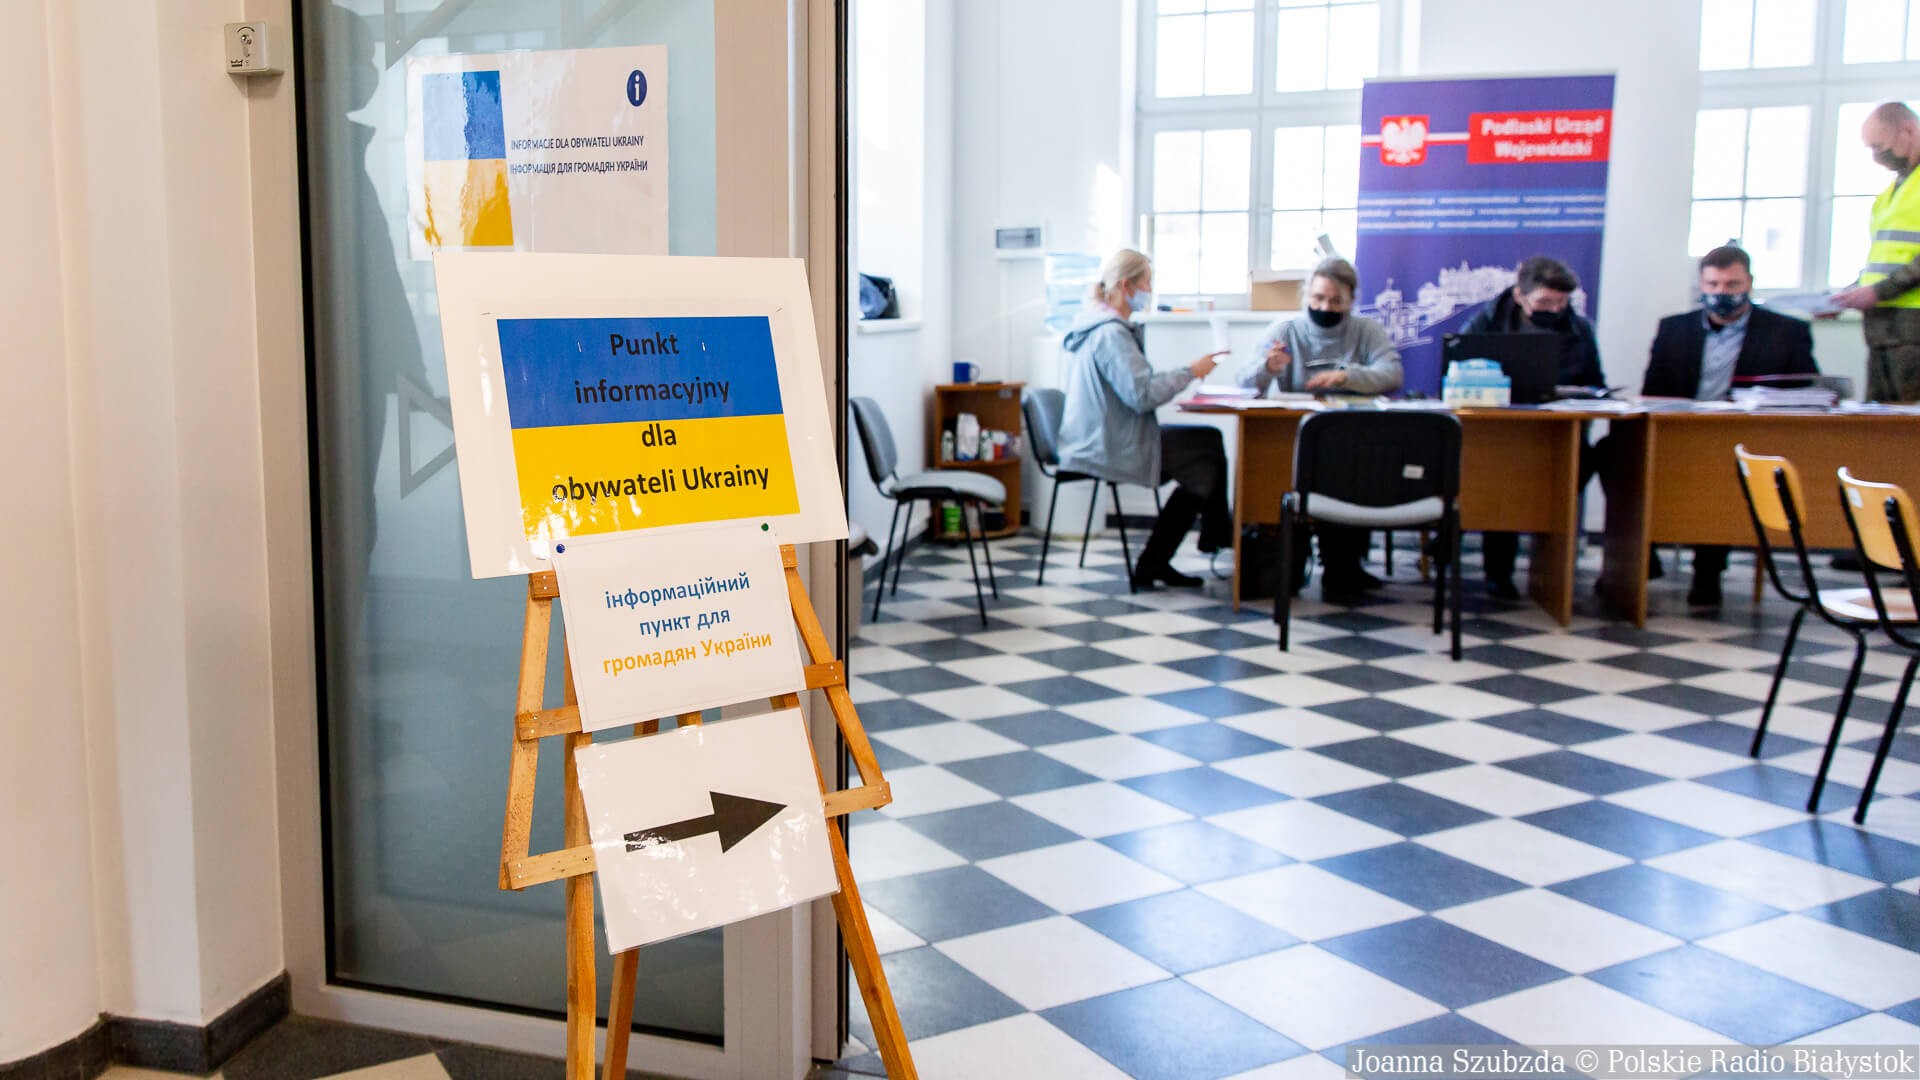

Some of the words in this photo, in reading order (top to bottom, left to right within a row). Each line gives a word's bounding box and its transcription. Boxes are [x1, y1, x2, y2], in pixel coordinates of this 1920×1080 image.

[1481, 117, 1552, 136] Podlaski
[1554, 115, 1605, 137] Urząd
[511, 137, 554, 150] INFORMACJE
[555, 137, 569, 149] DLA
[570, 136, 611, 149] OBYWATELI
[612, 135, 644, 147] UKRAINY
[1494, 139, 1592, 161] Wojewódzki
[510, 162, 556, 175] ІНФОРМАЦІЯ
[557, 162, 573, 175] ДЛЯ
[574, 161, 615, 174] ГРОМАДЯН
[616, 158, 648, 172] УКРАЇНИ
[609, 332, 680, 356] Punkt
[574, 377, 730, 404] informacyjny
[641, 423, 677, 447] dla
[552, 469, 677, 506] obywateli
[682, 464, 769, 491] Ukrainy
[604, 572, 751, 609] інформаційний
[639, 615, 691, 638] пункт
[697, 609, 731, 631] для
[603, 645, 697, 676] громадян
[700, 632, 773, 658] України
